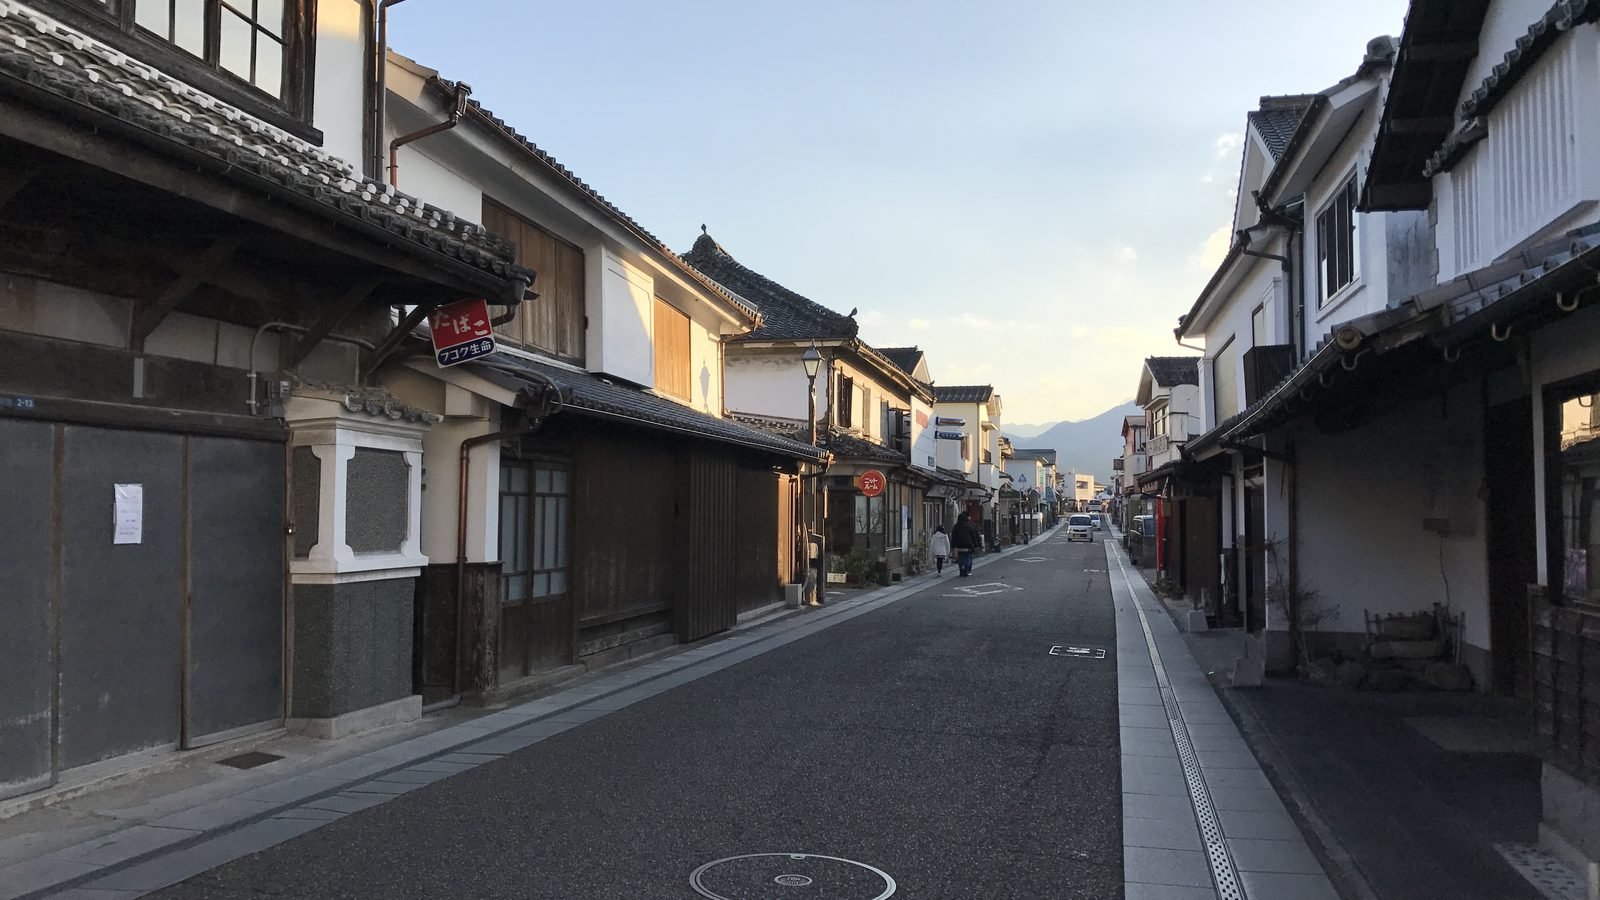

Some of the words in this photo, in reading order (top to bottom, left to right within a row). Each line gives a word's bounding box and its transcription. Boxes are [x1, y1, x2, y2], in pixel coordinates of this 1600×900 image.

[433, 310, 488, 336] たばこ
[440, 340, 491, 362] フコク生命
